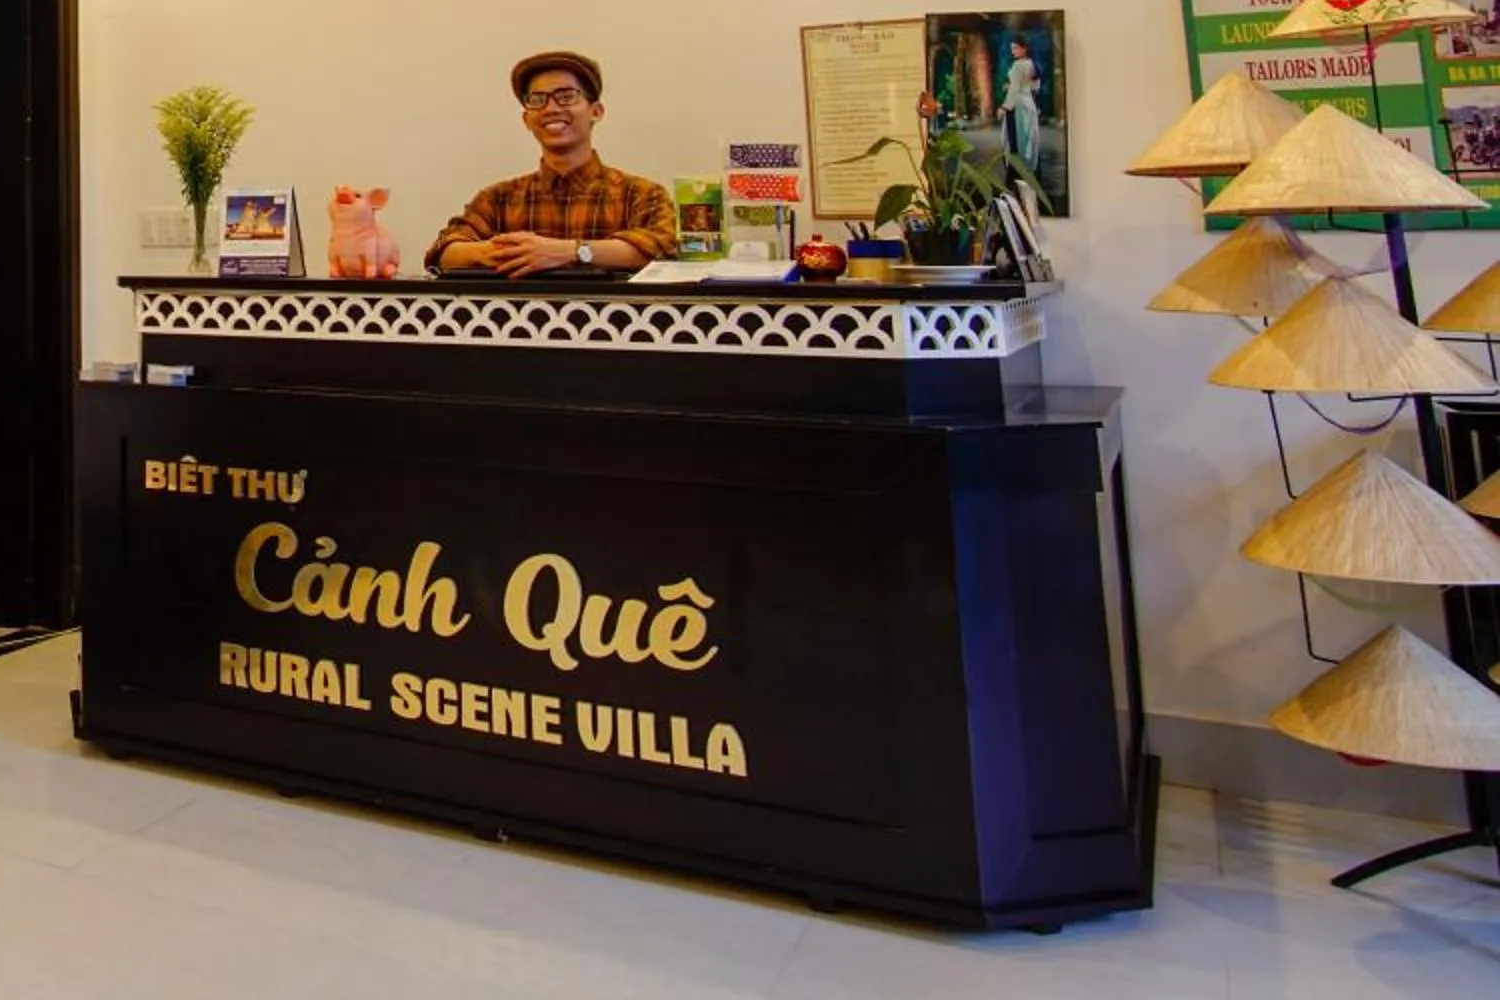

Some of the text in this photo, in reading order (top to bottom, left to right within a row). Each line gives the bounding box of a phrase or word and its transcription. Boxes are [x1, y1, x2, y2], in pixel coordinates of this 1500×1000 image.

[1244, 55, 1373, 81] TAILORS MADE
[235, 521, 719, 671] Cảnh Quê
[219, 641, 749, 778] RURAL SCENE VILLA
